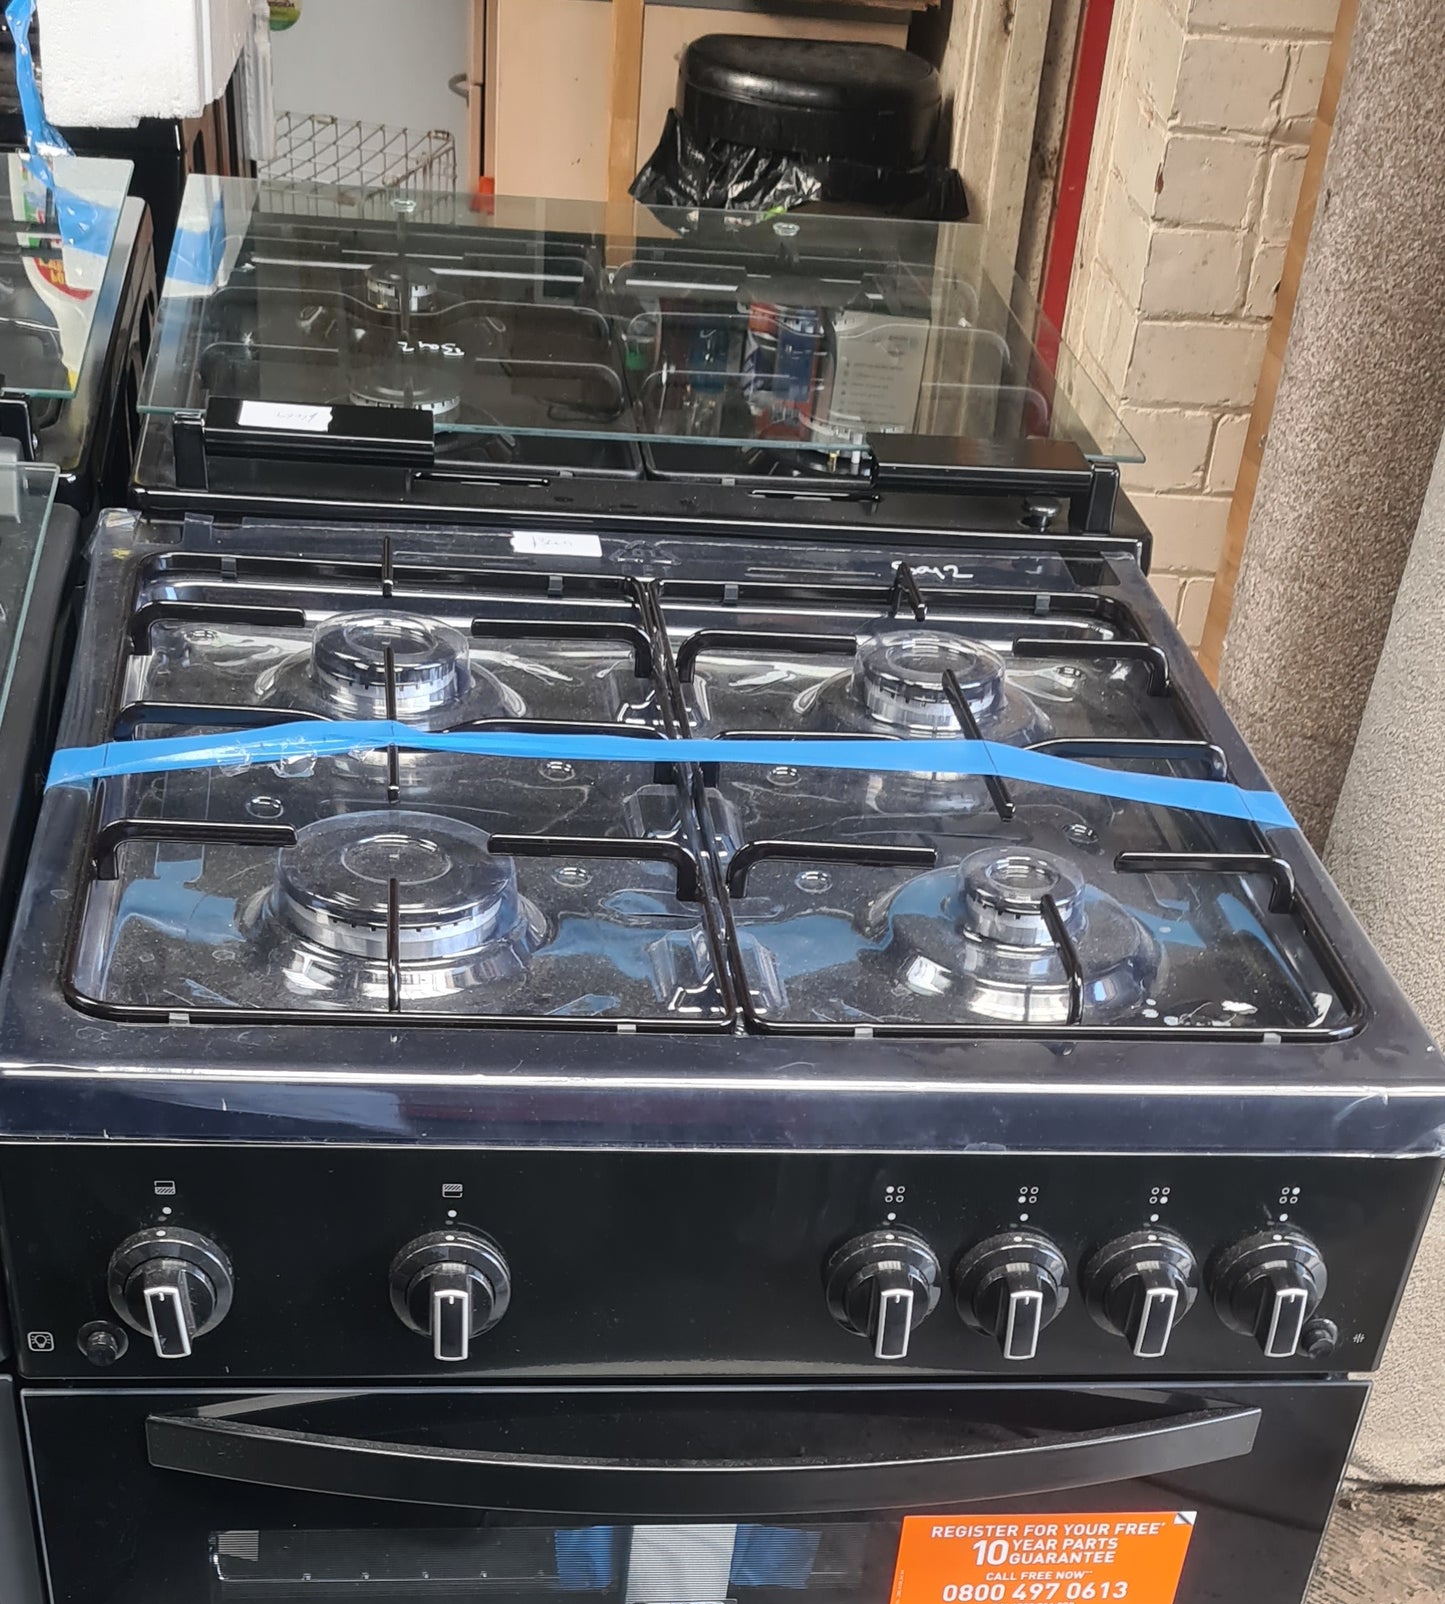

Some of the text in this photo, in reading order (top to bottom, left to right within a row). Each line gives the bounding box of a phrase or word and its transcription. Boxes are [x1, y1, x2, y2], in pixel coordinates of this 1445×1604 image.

[931, 1525, 1019, 1538] REGISTER
[1023, 1524, 1059, 1537] FOR
[1063, 1523, 1110, 1536] YOUR
[1012, 1537, 1118, 1551] YEAR PARTS
[972, 1539, 1009, 1566] 10
[1008, 1551, 1116, 1565] GUARANTEE
[986, 1572, 1017, 1581] CALL
[1020, 1571, 1053, 1581] FREE
[942, 1581, 1129, 1602] 0800 497 0613
